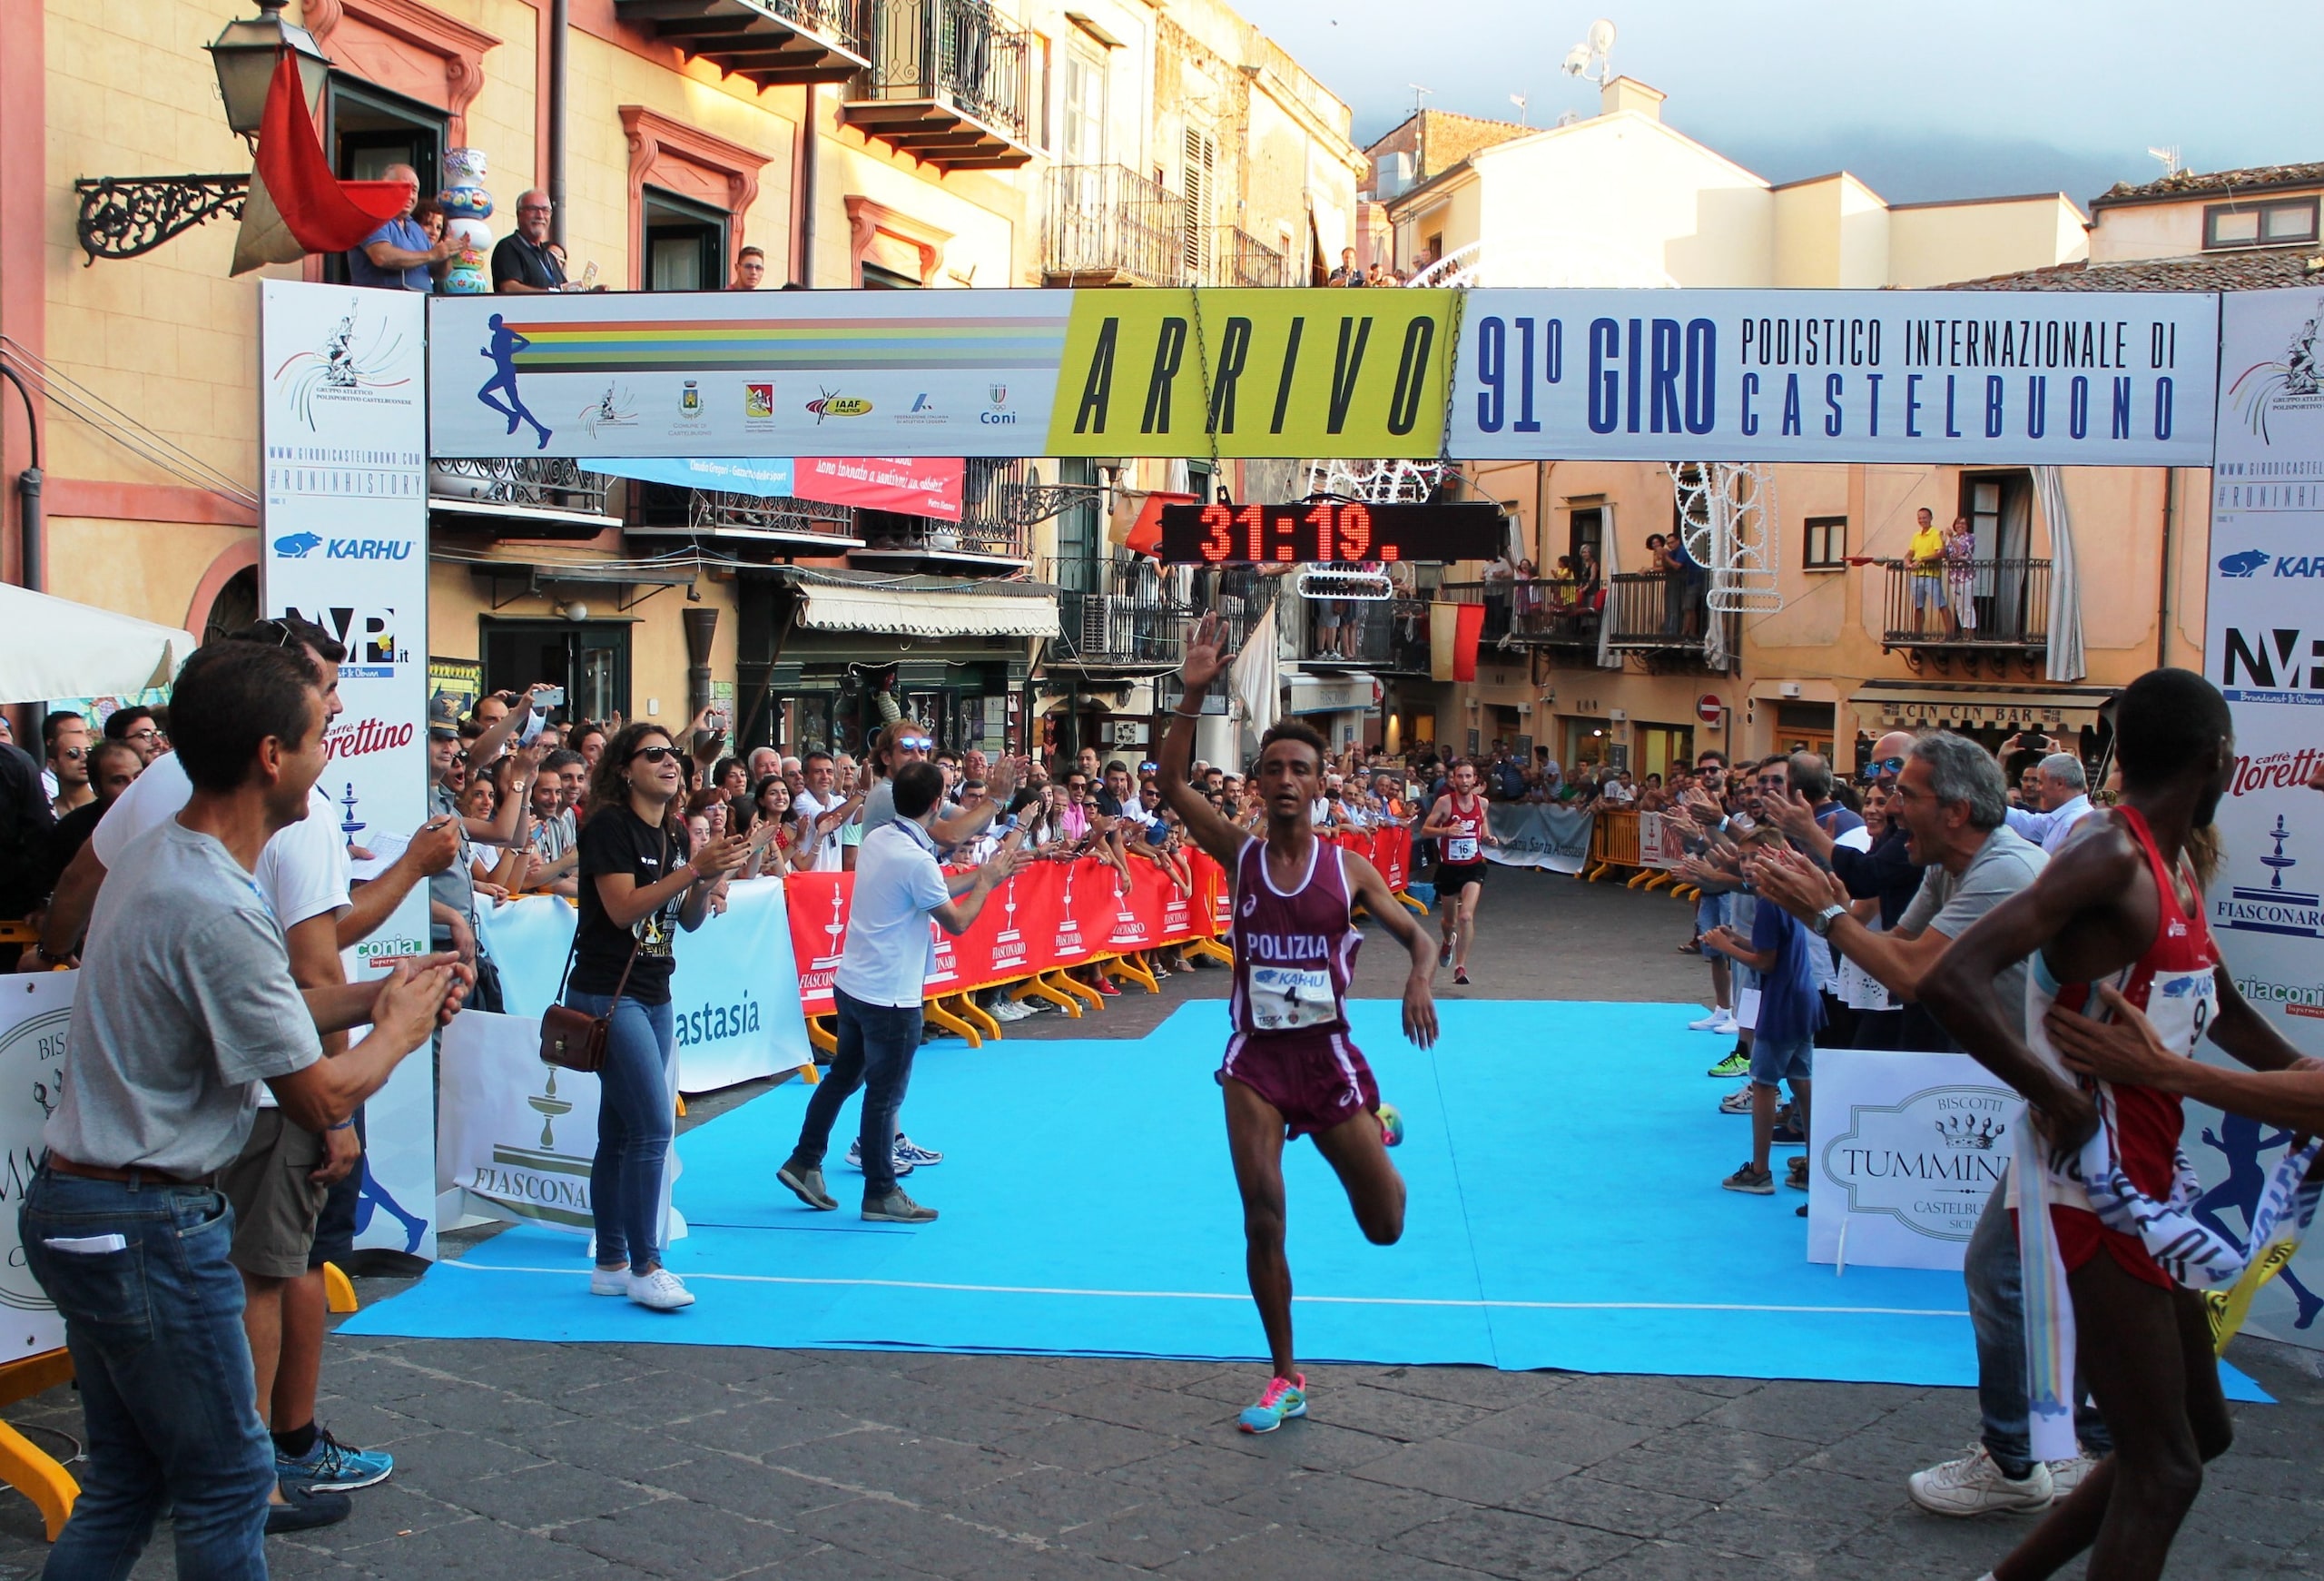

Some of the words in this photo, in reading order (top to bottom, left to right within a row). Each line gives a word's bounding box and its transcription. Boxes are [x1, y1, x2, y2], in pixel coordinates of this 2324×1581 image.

[1741, 318, 1881, 366] PODISTICO
[1905, 319, 2127, 369] INTERNAZIONALE
[2151, 321, 2176, 369] DI
[1074, 316, 1435, 435] ARRIVO
[1589, 317, 1716, 434] GIRO
[836, 400, 861, 408] IAAF
[1741, 371, 2173, 441] CASTELBUONO
[980, 411, 1016, 424] Coni
[269, 446, 420, 466] WWW.GIRODICASTELBUONO.COM
[815, 459, 836, 475] sono
[838, 460, 868, 481] tornato
[868, 471, 875, 482] a
[271, 469, 420, 495] #RUNINHISTORY
[327, 539, 411, 560] KARHU
[2240, 691, 2288, 704] Broadcast
[1907, 705, 1938, 717] CIN
[1950, 705, 1983, 719] CIN
[1995, 707, 2033, 722] BAR
[2255, 753, 2290, 765] caffè
[1459, 844, 1469, 855] 16
[992, 942, 1026, 960] FIASCONARO
[1246, 933, 1329, 960] POLIZIA
[1284, 986, 1299, 1008] 4
[2191, 998, 2207, 1046] 9
[1937, 1096, 2003, 1113] BISCOTTI
